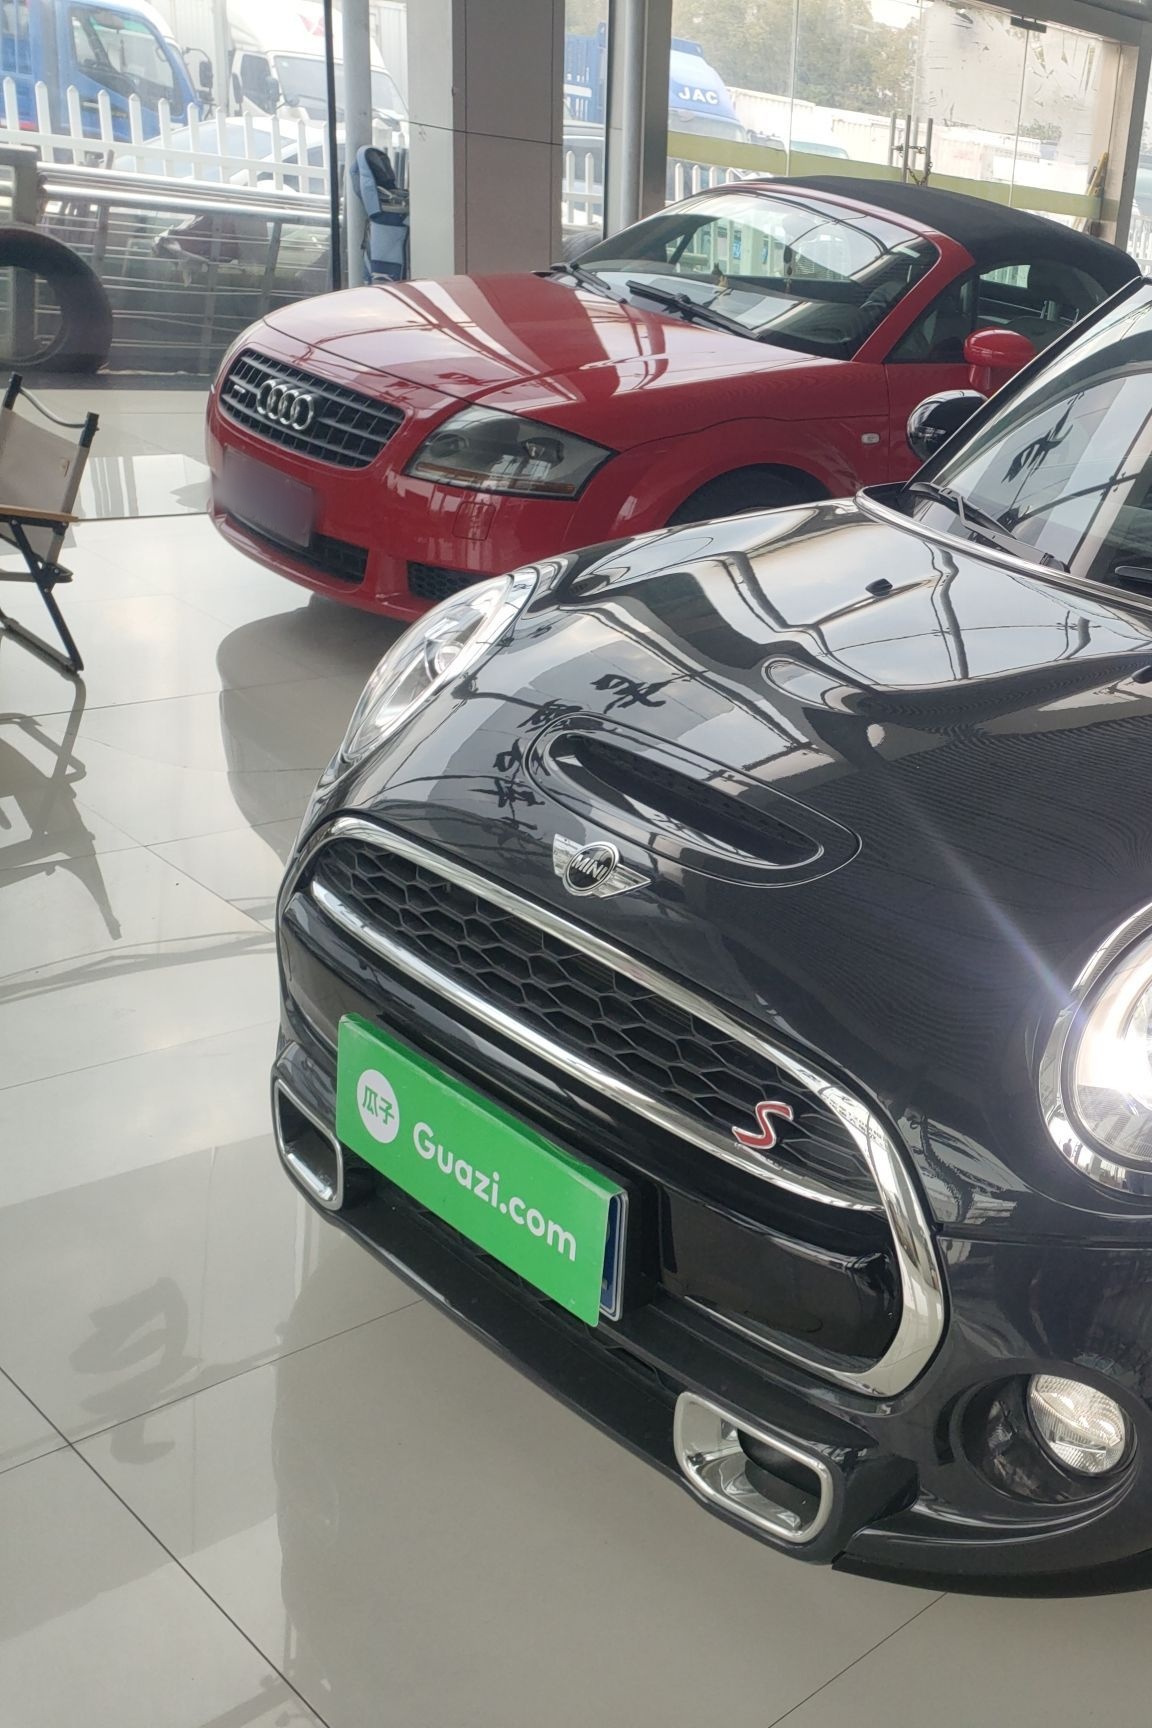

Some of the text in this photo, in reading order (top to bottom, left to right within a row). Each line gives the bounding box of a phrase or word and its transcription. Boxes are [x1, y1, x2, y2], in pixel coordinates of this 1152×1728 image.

[677, 86, 718, 105] JAC
[571, 854, 609, 881] MINI
[731, 1100, 794, 1150] S
[362, 1085, 577, 1262] 瓜子 Guazi.com
